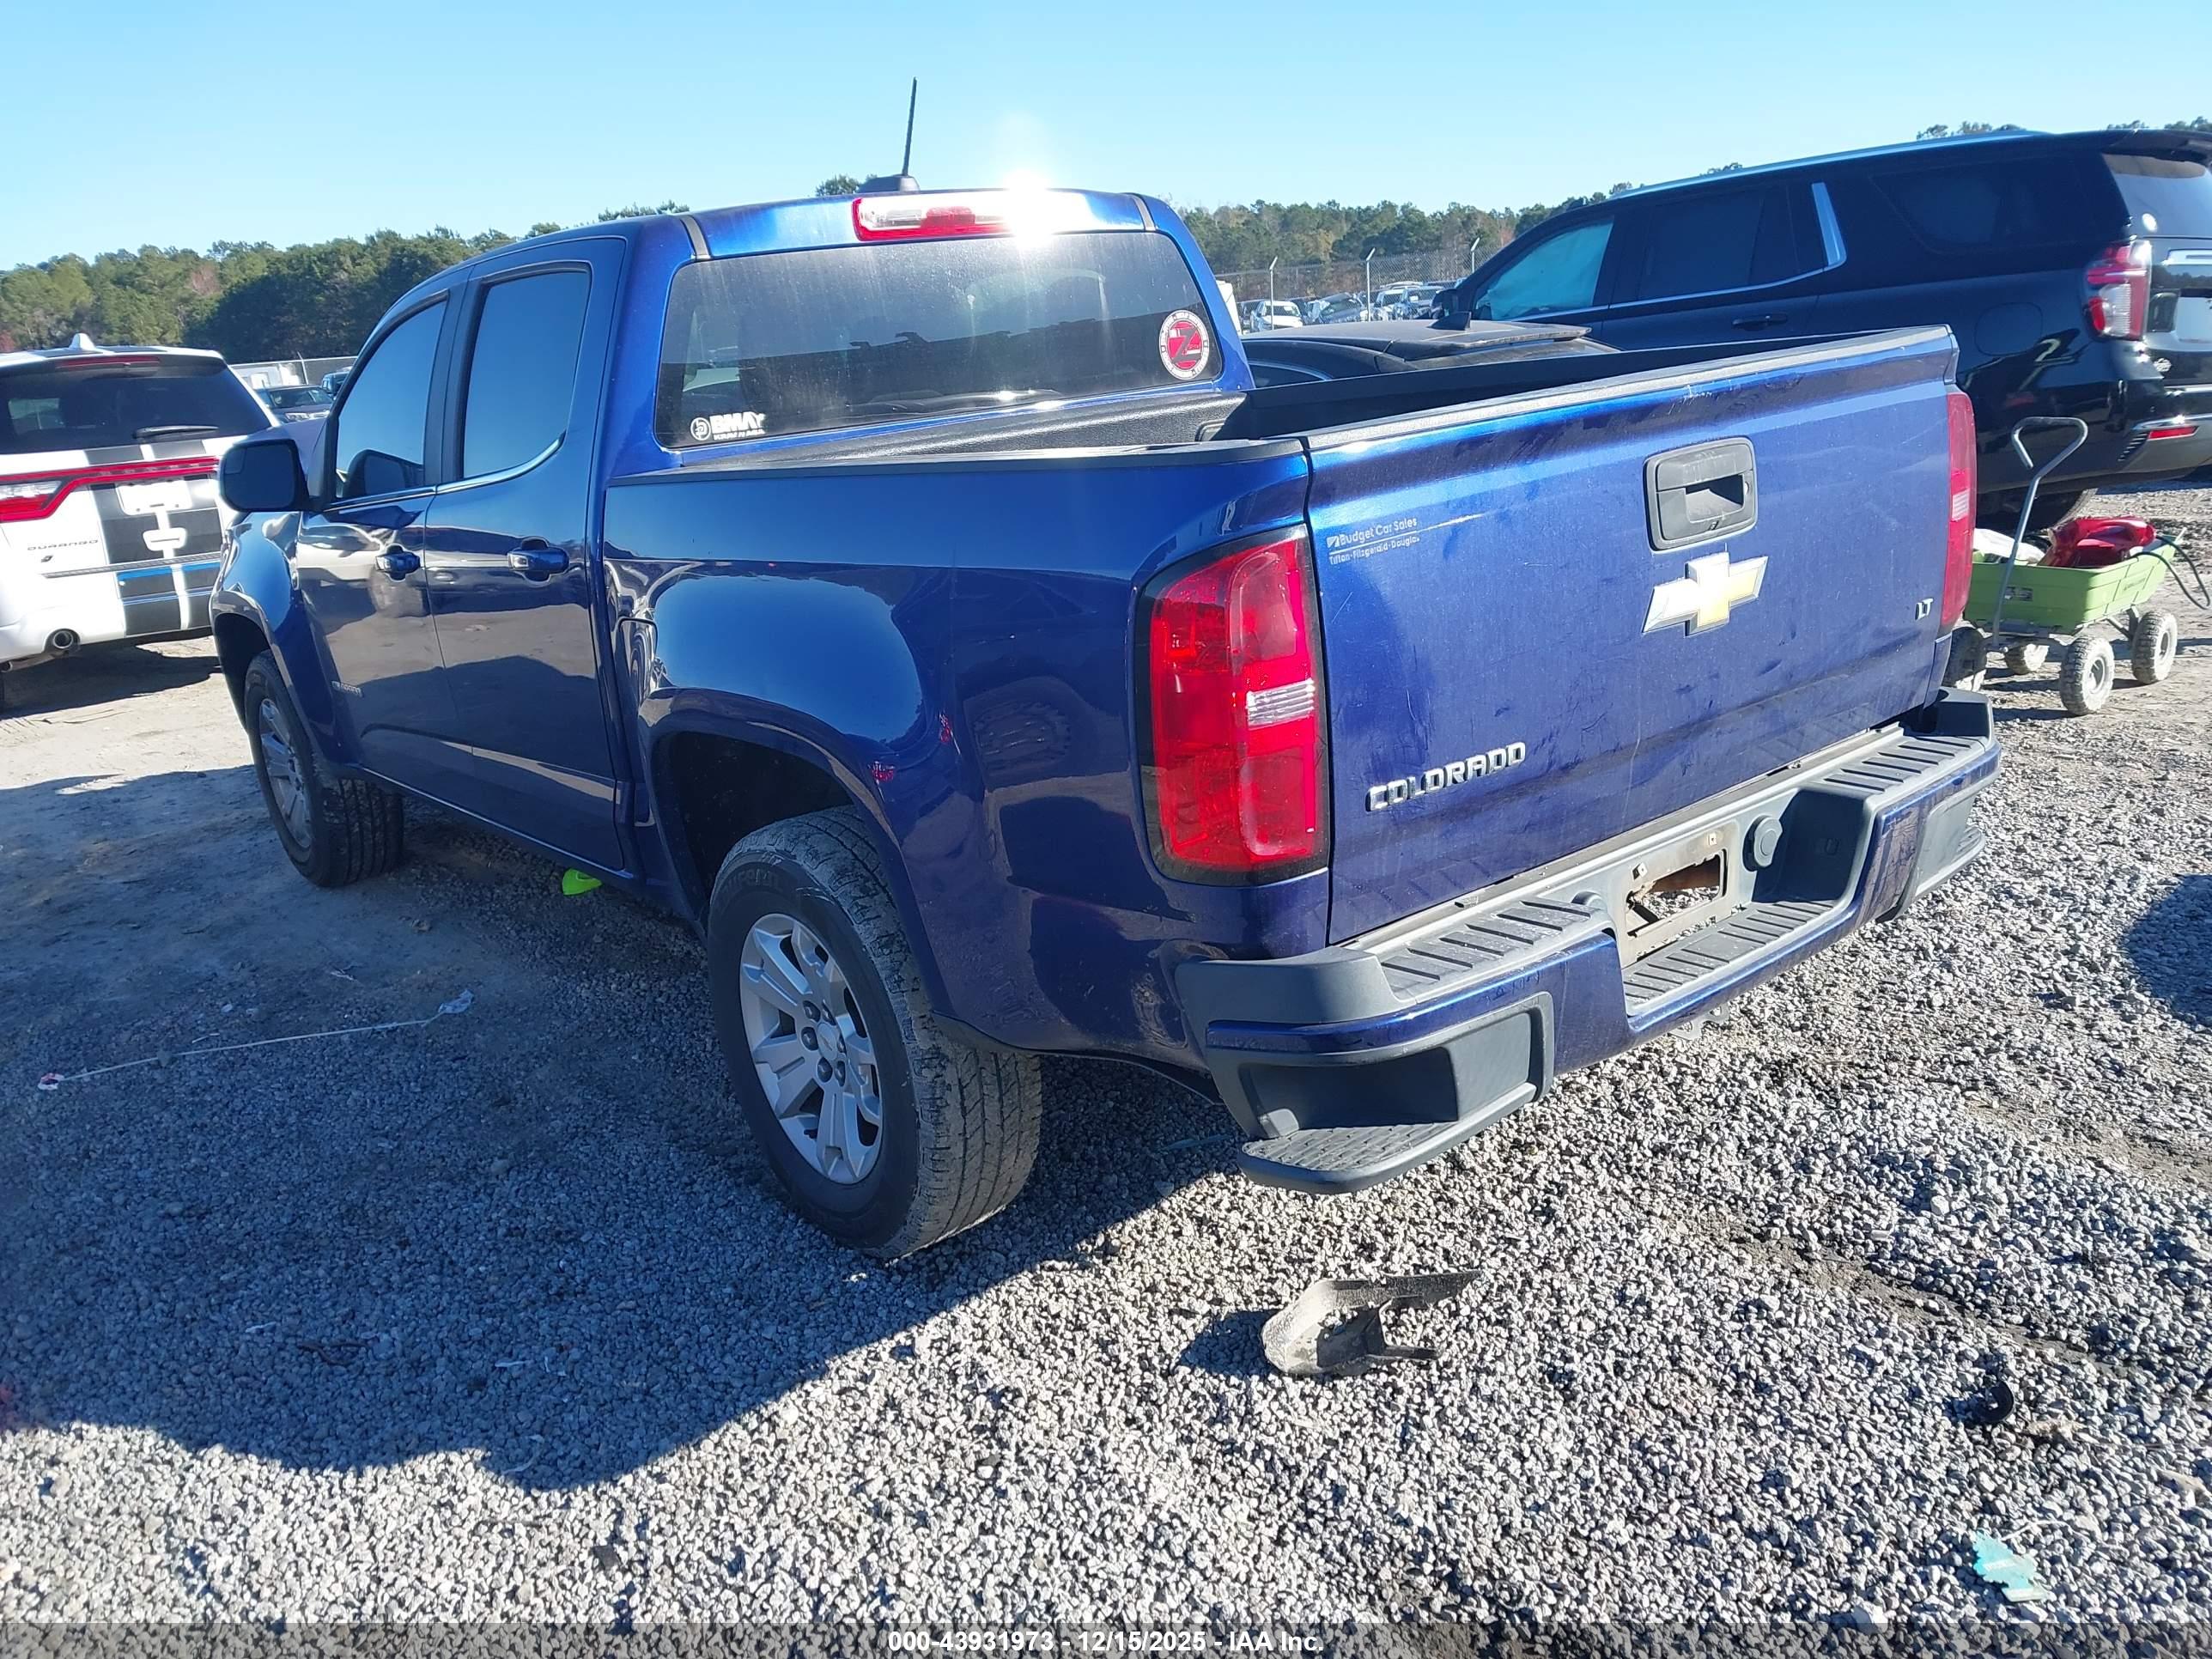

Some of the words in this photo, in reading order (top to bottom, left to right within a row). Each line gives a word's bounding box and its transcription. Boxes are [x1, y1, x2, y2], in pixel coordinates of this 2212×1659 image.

[1339, 527, 1375, 545] Budget
[1376, 524, 1392, 536] Car
[1393, 518, 1418, 531] Sales
[1915, 598, 1934, 620] LT
[1365, 742, 1526, 811] COLORADO
